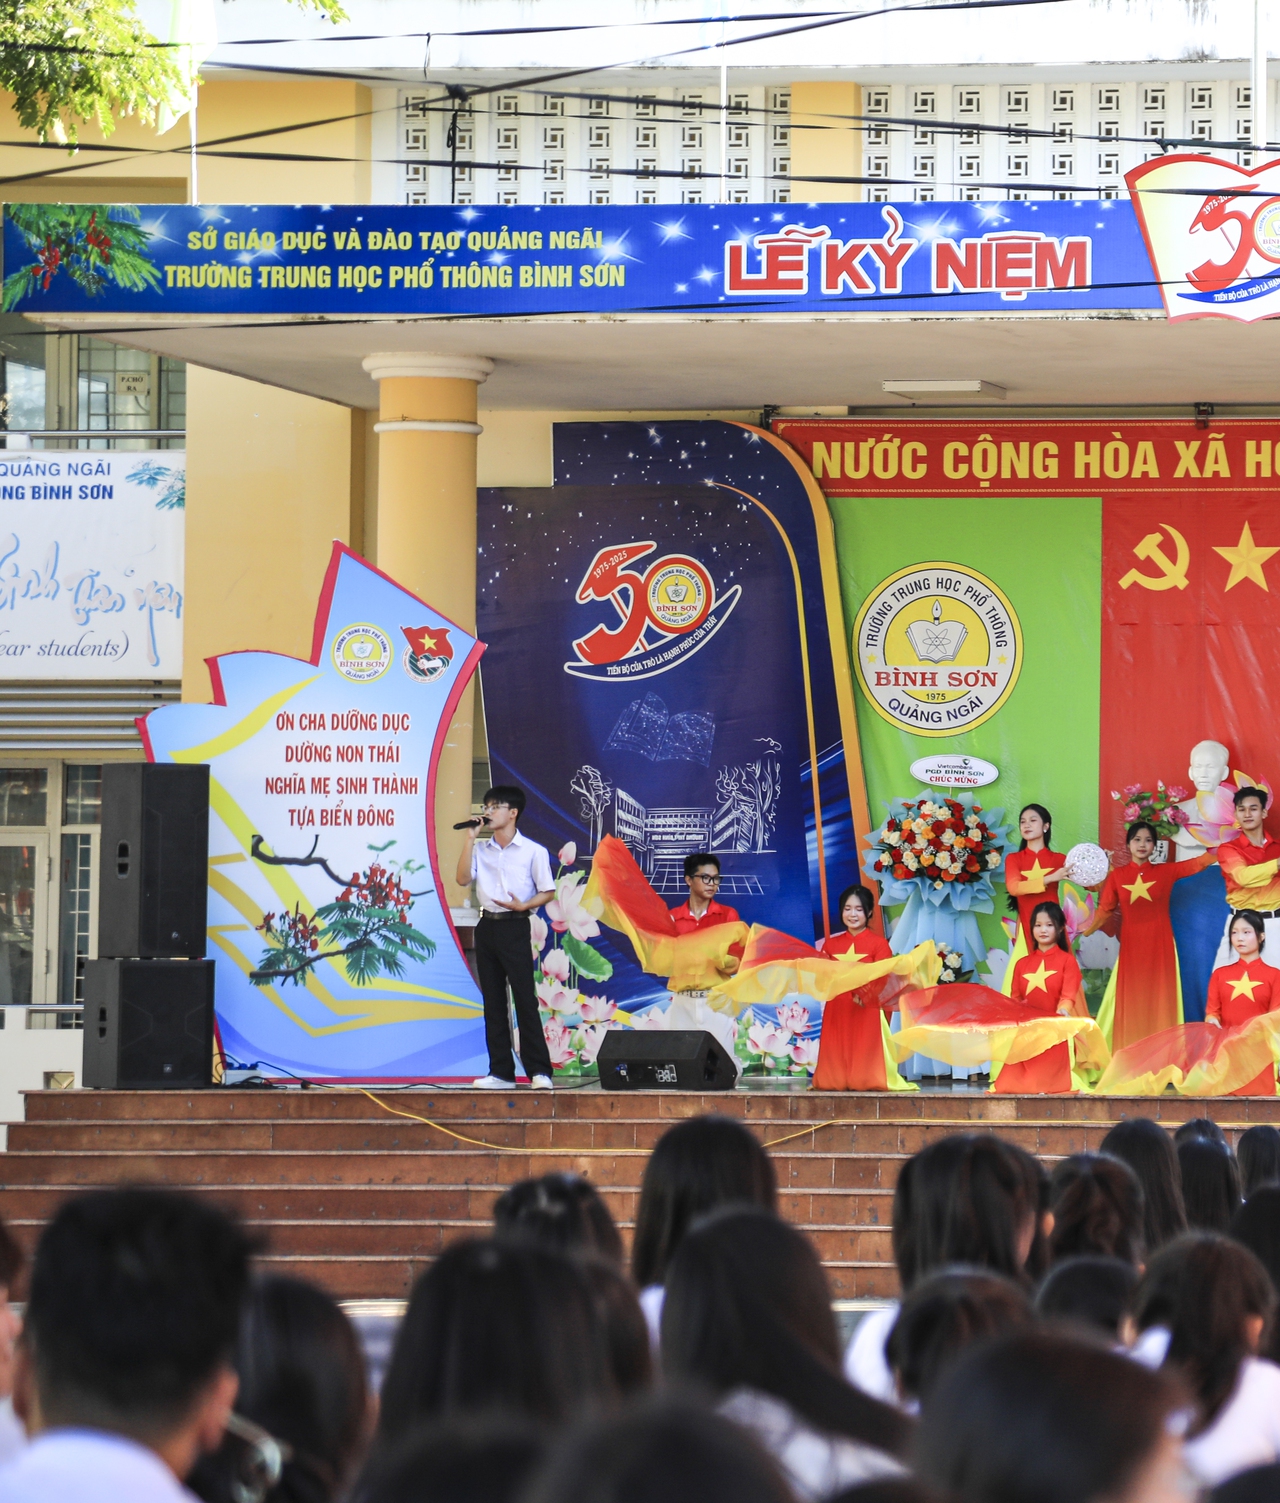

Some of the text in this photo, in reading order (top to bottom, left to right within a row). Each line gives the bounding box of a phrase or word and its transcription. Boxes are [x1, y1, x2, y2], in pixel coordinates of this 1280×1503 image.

[187, 225, 603, 254] SỞ GIÁO DỤC VÀ ĐÀO TẠO QUẢNG NGÃI
[726, 207, 1090, 299] LỄ KỶ NIỆM
[165, 257, 625, 292] TRƯỜNG TRUNG HỌC PHỔ THÔNG BÌNH SƠN
[67, 459, 111, 477] NGÃI
[812, 433, 927, 479] NƯỚC
[943, 434, 1059, 487] CỘNG
[1074, 432, 1160, 478] HÒA
[1174, 432, 1231, 478] XÃ
[31, 483, 72, 500] BÌNH
[79, 484, 114, 500] SƠN
[593, 550, 628, 579] 1975-2025
[656, 604, 697, 612] BÌNH SƠN
[866, 577, 1008, 648] TRƯỜNG TRUNG HỌC PHỔ THÔNG
[37, 630, 130, 662] students)
[606, 664, 622, 675] TIẾN
[622, 664, 630, 675] BỘ
[630, 661, 643, 672] CỦA
[643, 657, 655, 669] TRÒ
[655, 654, 663, 665] LÀ
[662, 646, 680, 663] HẠNH
[694, 628, 707, 643] CỦA
[340, 659, 385, 668] BÌNH SƠN
[875, 667, 998, 687] BÌNH SƠN
[888, 696, 984, 723] QUẢNG NGÃI
[926, 692, 946, 701] 1975
[276, 709, 410, 735] ƠN CHA DƯỠNG DỤC
[285, 740, 400, 763] DƯỜNG NON THÁI
[265, 772, 418, 798] NGHĨA MẸ SINH THÀNH
[288, 799, 394, 830] TỰA BIỂN ĐÔNG
